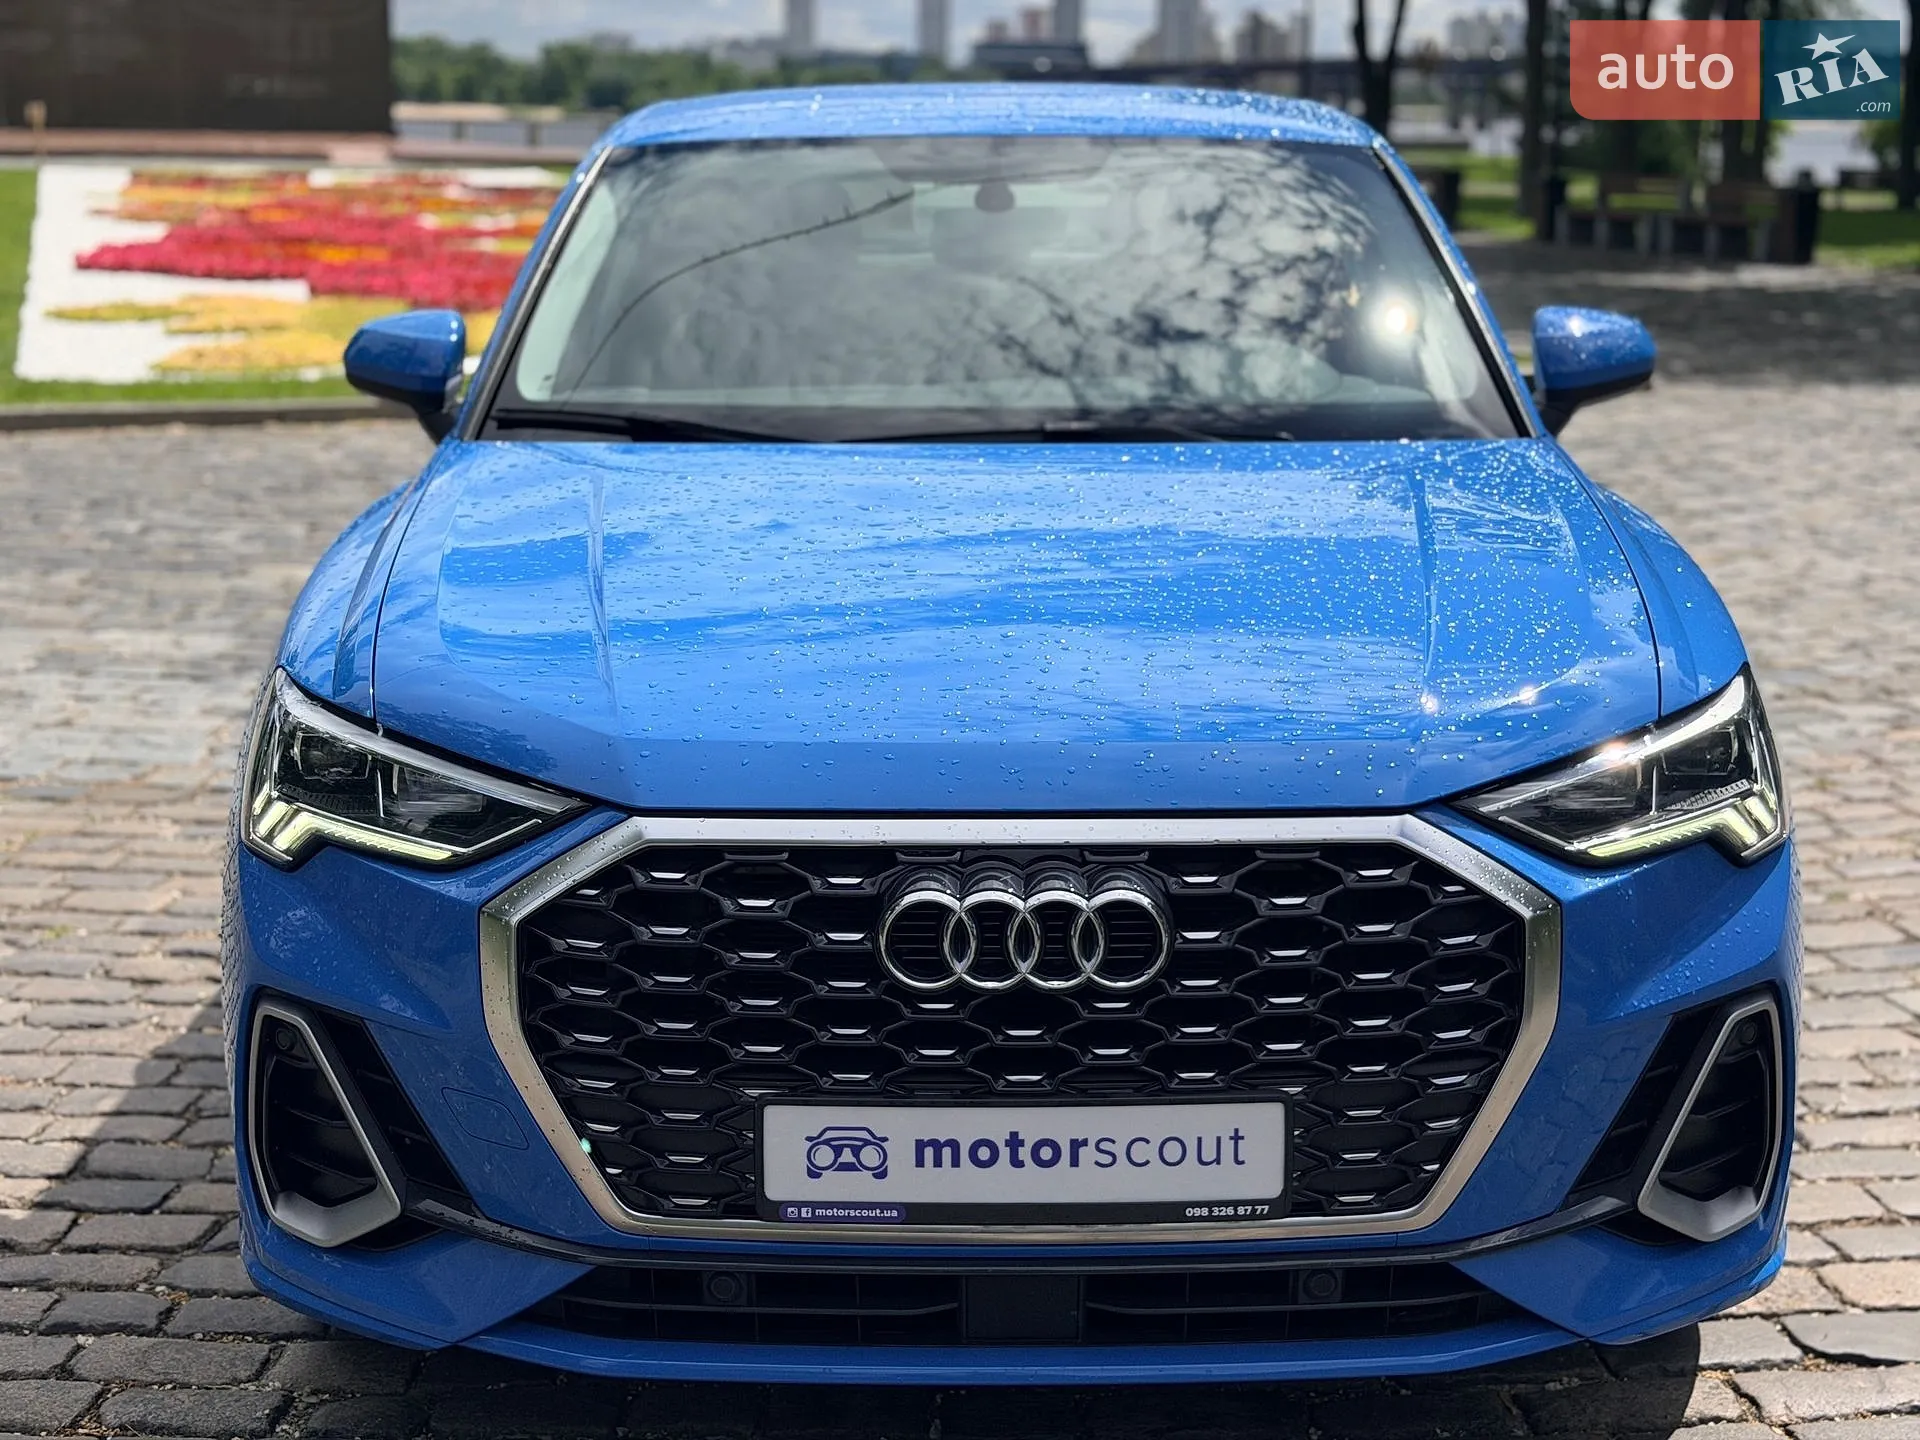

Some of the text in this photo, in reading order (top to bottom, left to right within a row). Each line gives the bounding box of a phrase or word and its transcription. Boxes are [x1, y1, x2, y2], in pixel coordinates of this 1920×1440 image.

[914, 1127, 1246, 1169] motorscout
[815, 1207, 898, 1217] motorscout.ua
[1185, 1205, 1270, 1217] 098 326 87 77
